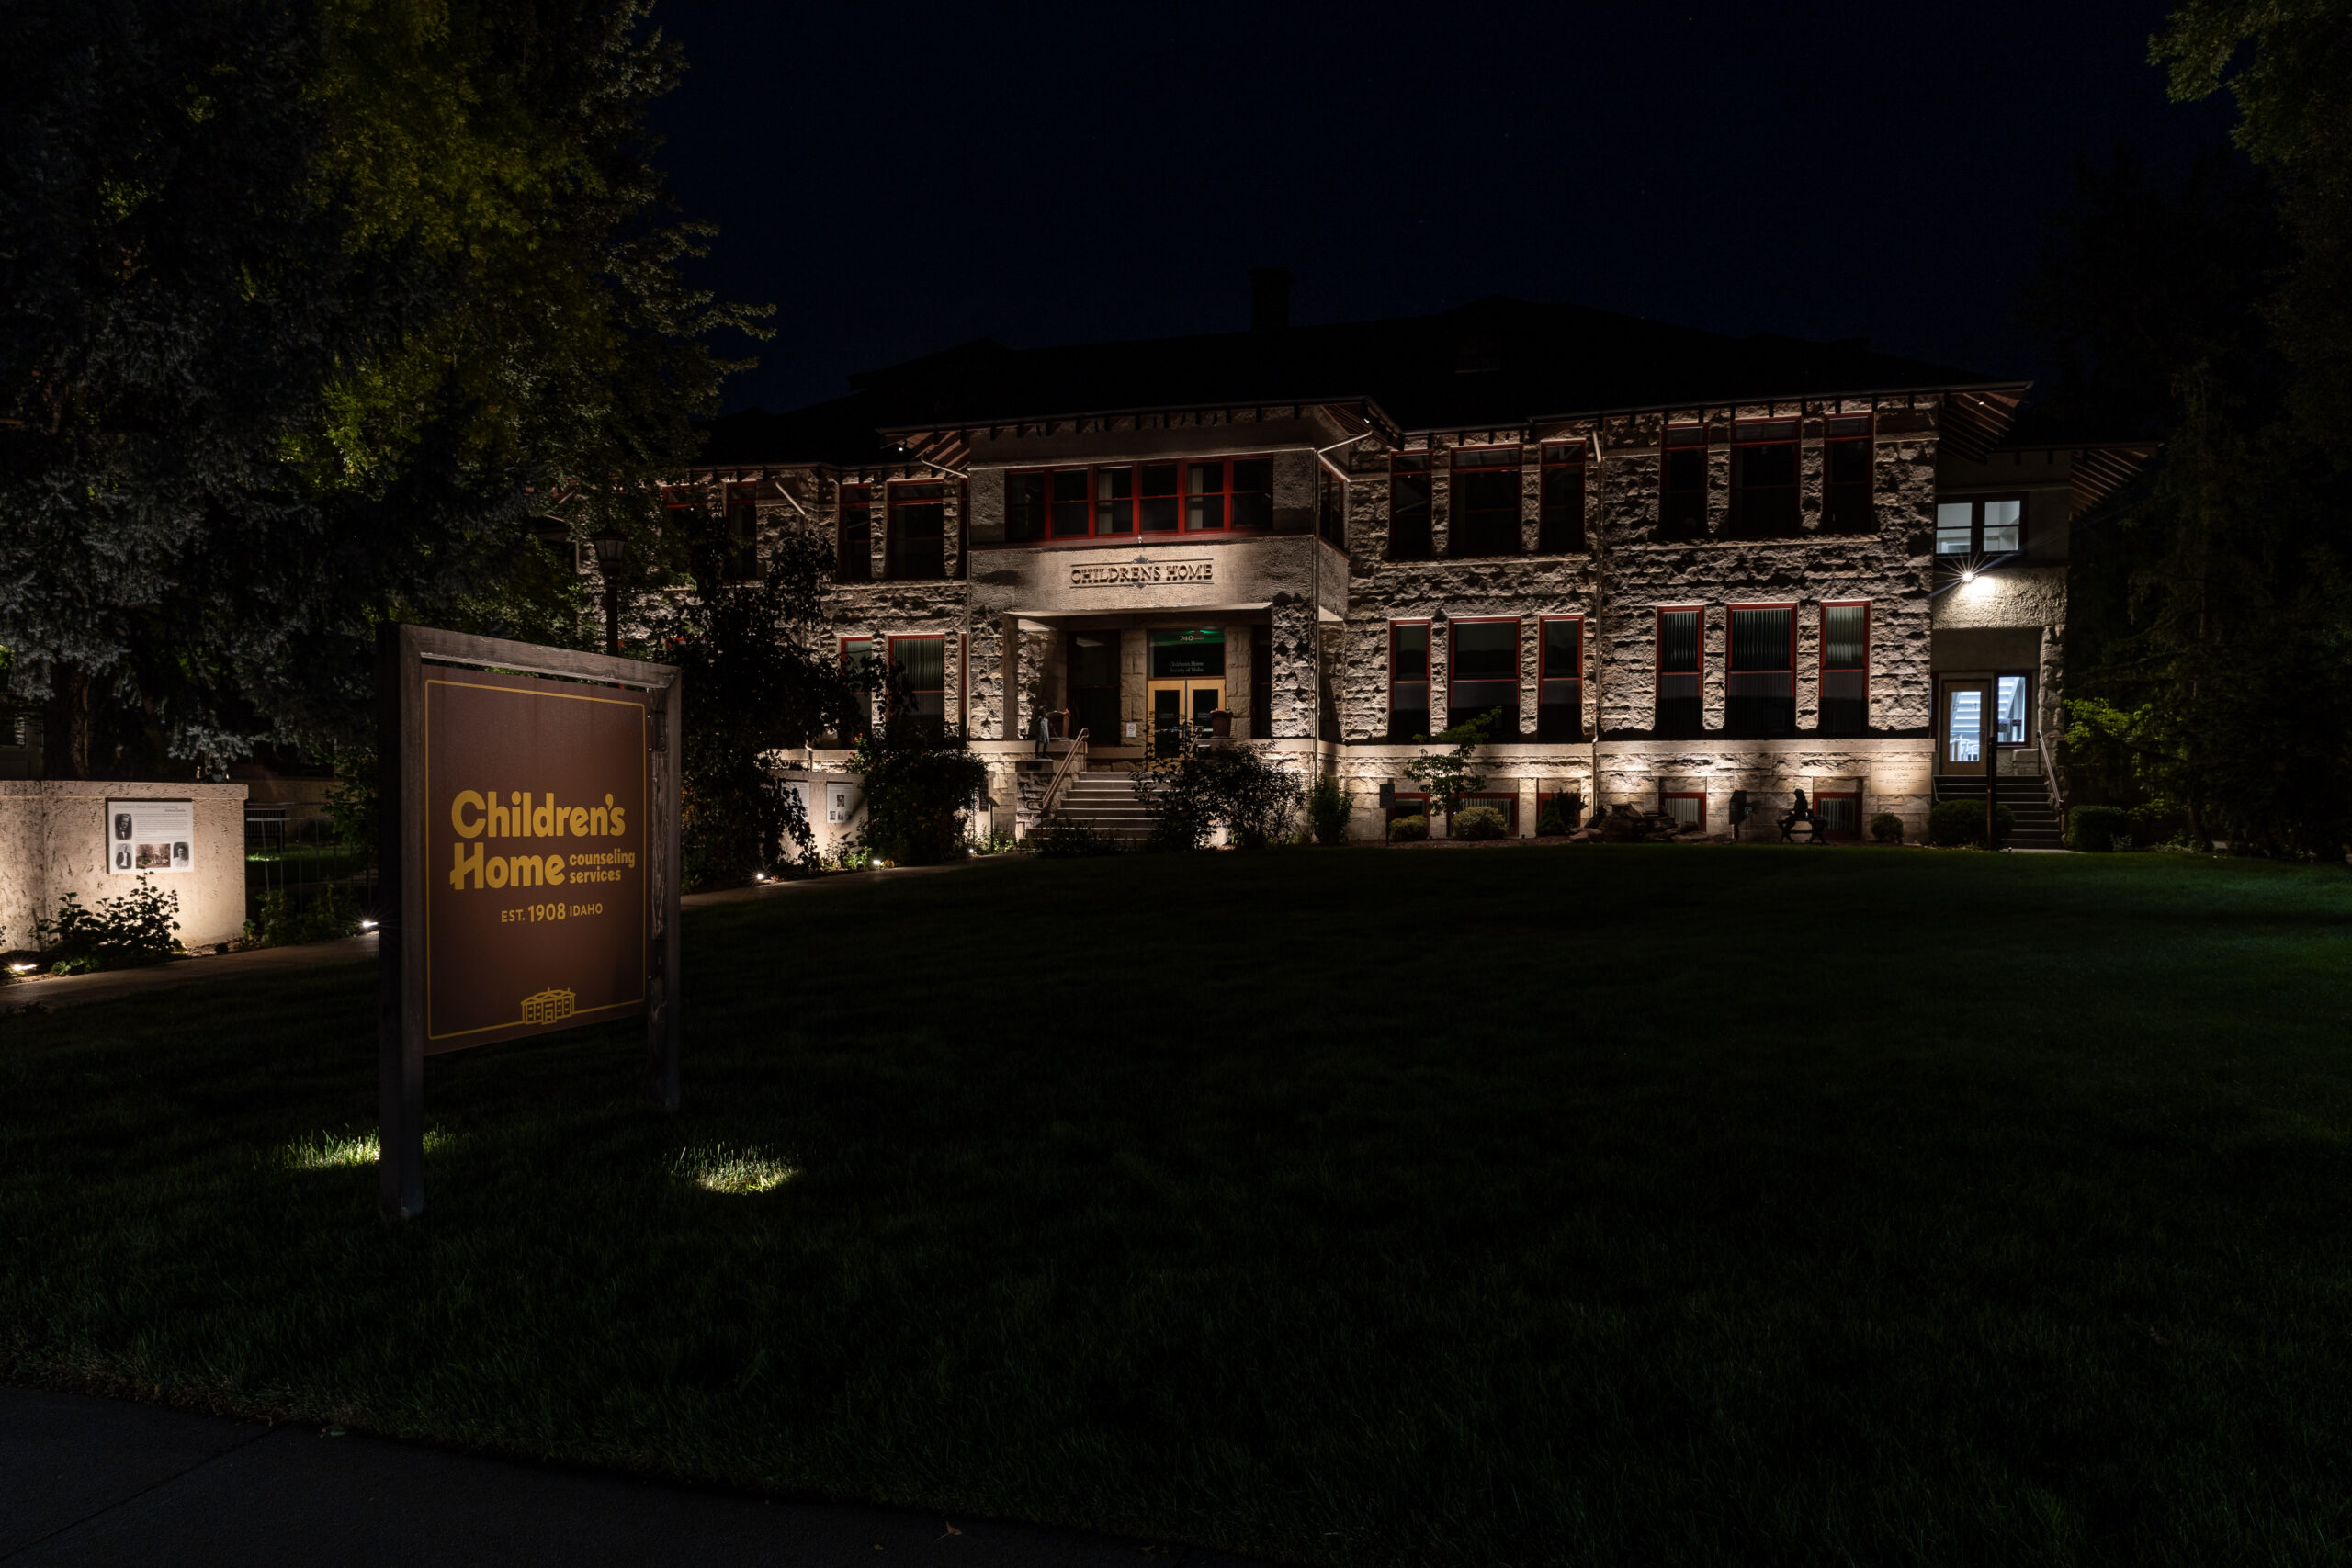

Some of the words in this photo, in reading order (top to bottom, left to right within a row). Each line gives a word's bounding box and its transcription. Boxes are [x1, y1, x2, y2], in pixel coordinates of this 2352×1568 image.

[1071, 567, 1160, 583] CHILDRENS
[1166, 564, 1213, 580] HOME
[451, 790, 626, 839] Children's
[449, 841, 566, 891] Home
[569, 848, 636, 868] counseling
[569, 866, 622, 885] services
[501, 908, 526, 923] EST.
[527, 902, 567, 923] 1908
[569, 903, 603, 918] IDAHO
